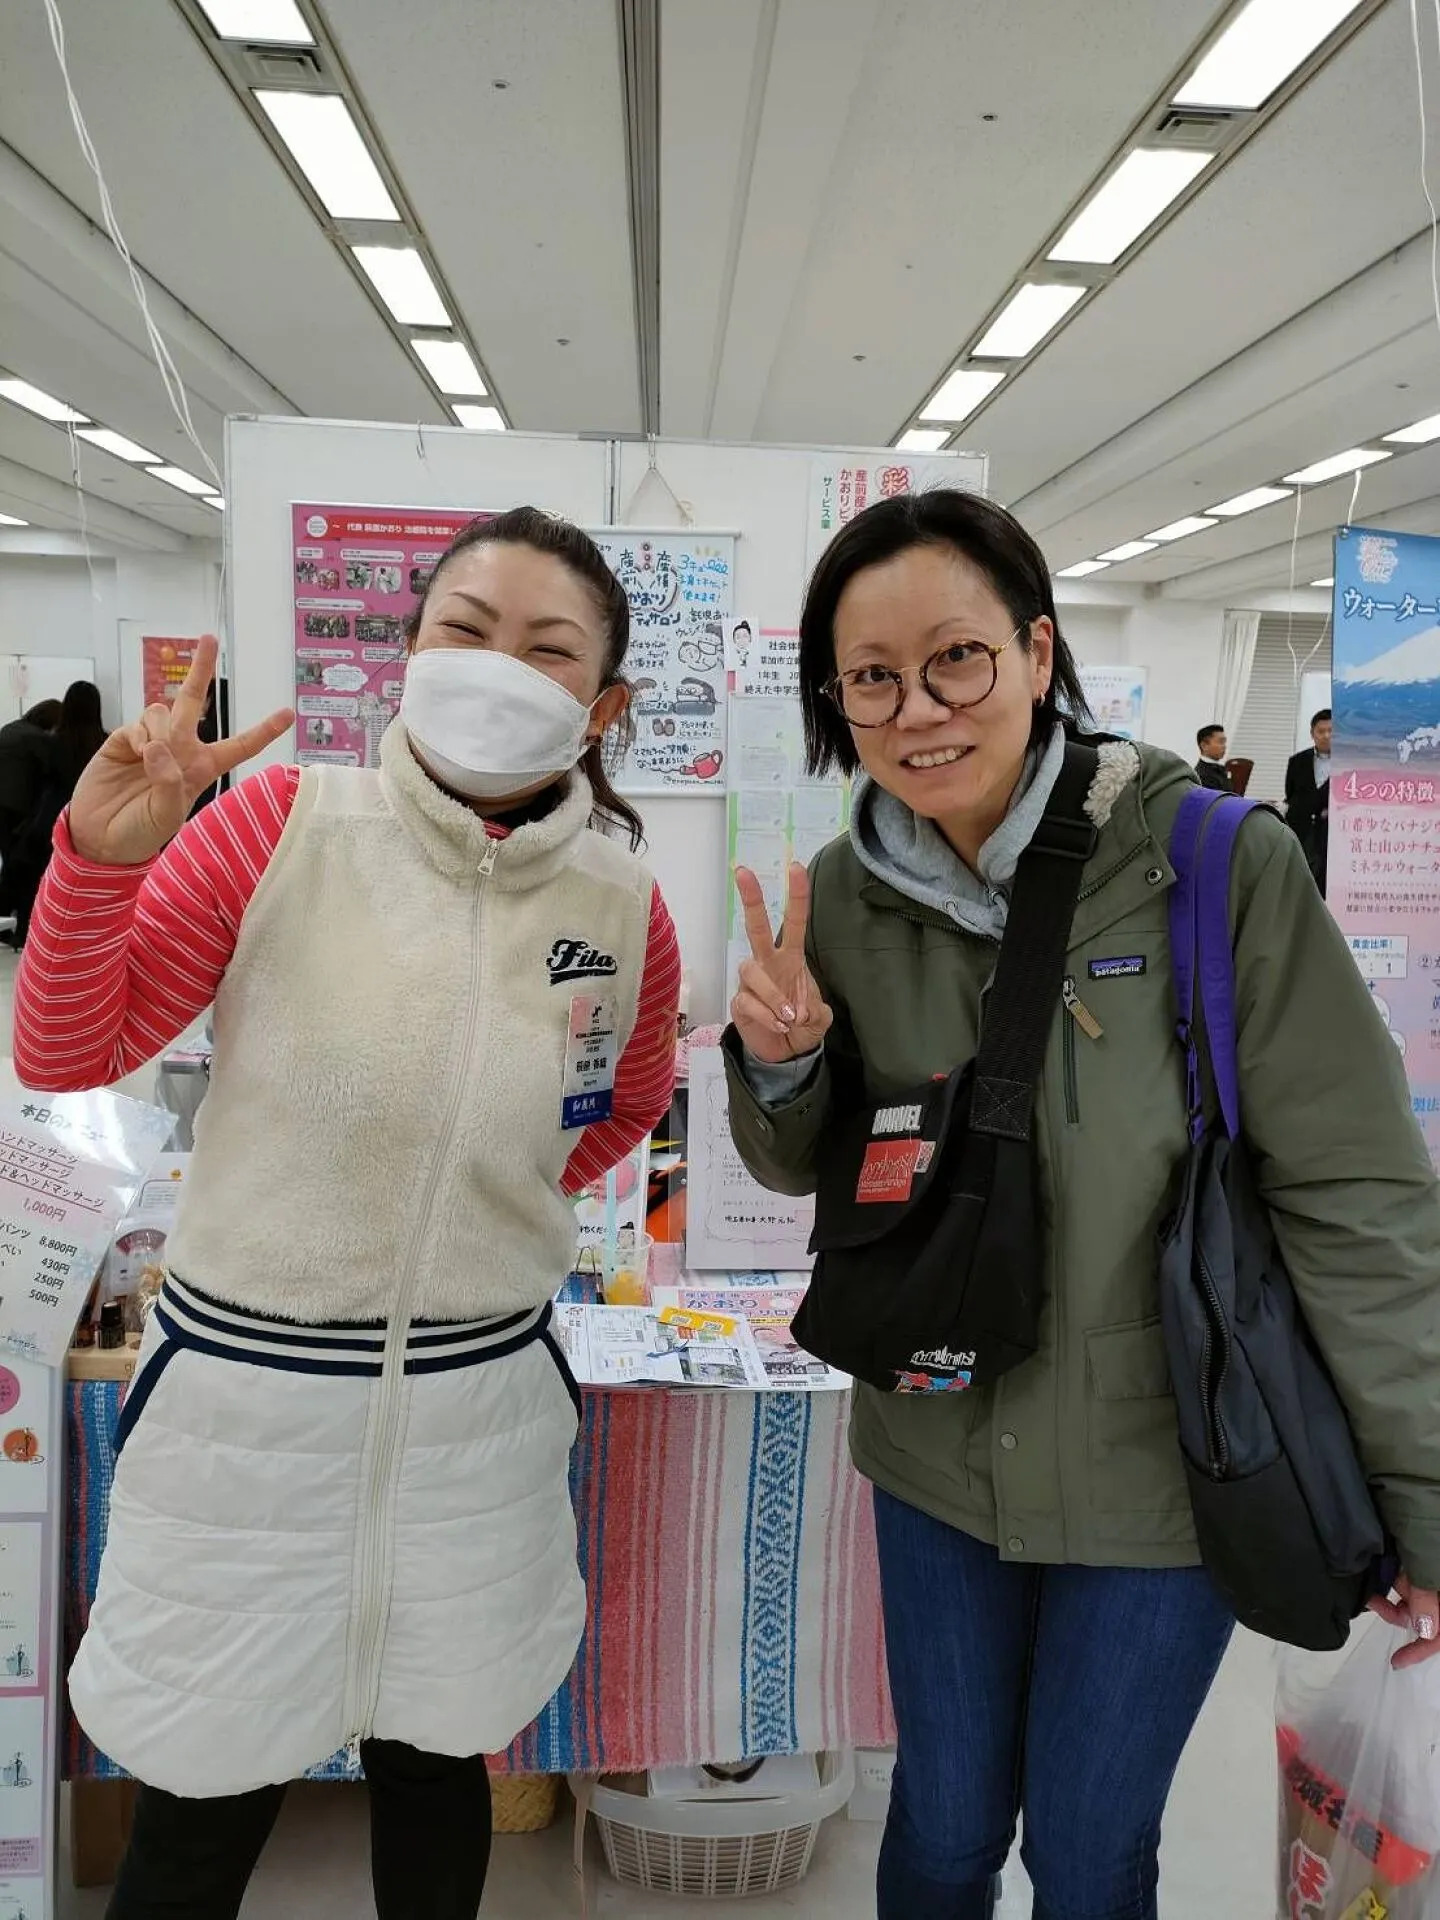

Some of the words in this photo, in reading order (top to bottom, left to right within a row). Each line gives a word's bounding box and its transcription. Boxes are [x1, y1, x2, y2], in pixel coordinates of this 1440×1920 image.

[1343, 588, 1440, 622] ウォーター
[546, 939, 617, 972] Fila
[1095, 965, 1140, 977] patagonia
[871, 1104, 923, 1136] MARVEL
[23, 1197, 67, 1221] 1,000円
[41, 1257, 71, 1276] 430円
[28, 1289, 59, 1308] 500円
